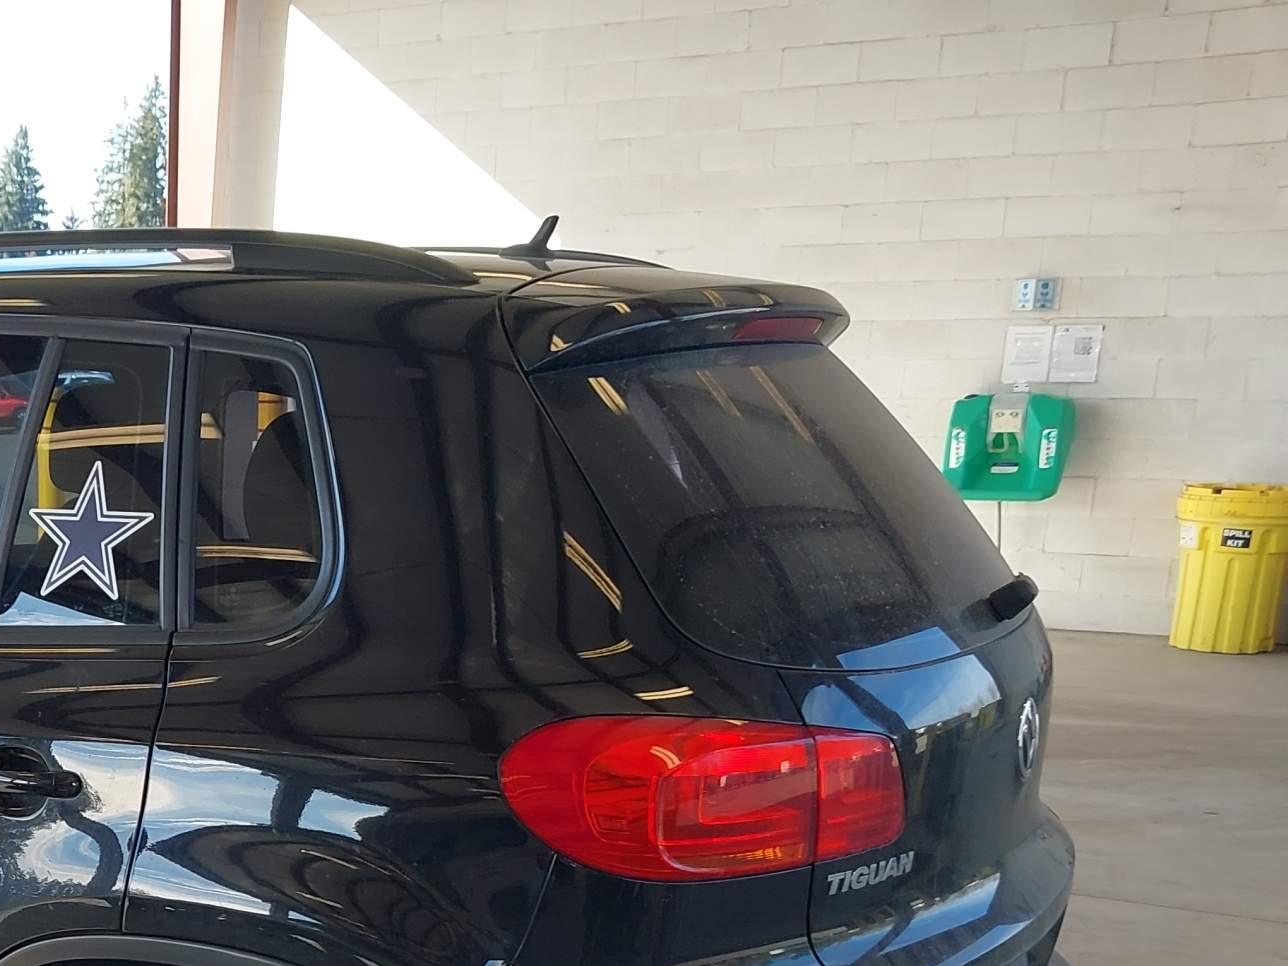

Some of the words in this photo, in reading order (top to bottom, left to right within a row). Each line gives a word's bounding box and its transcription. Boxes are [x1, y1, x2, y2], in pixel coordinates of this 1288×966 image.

[1223, 529, 1251, 538] SPILL
[1226, 538, 1245, 548] KIT
[827, 850, 915, 896] TIGUAN
